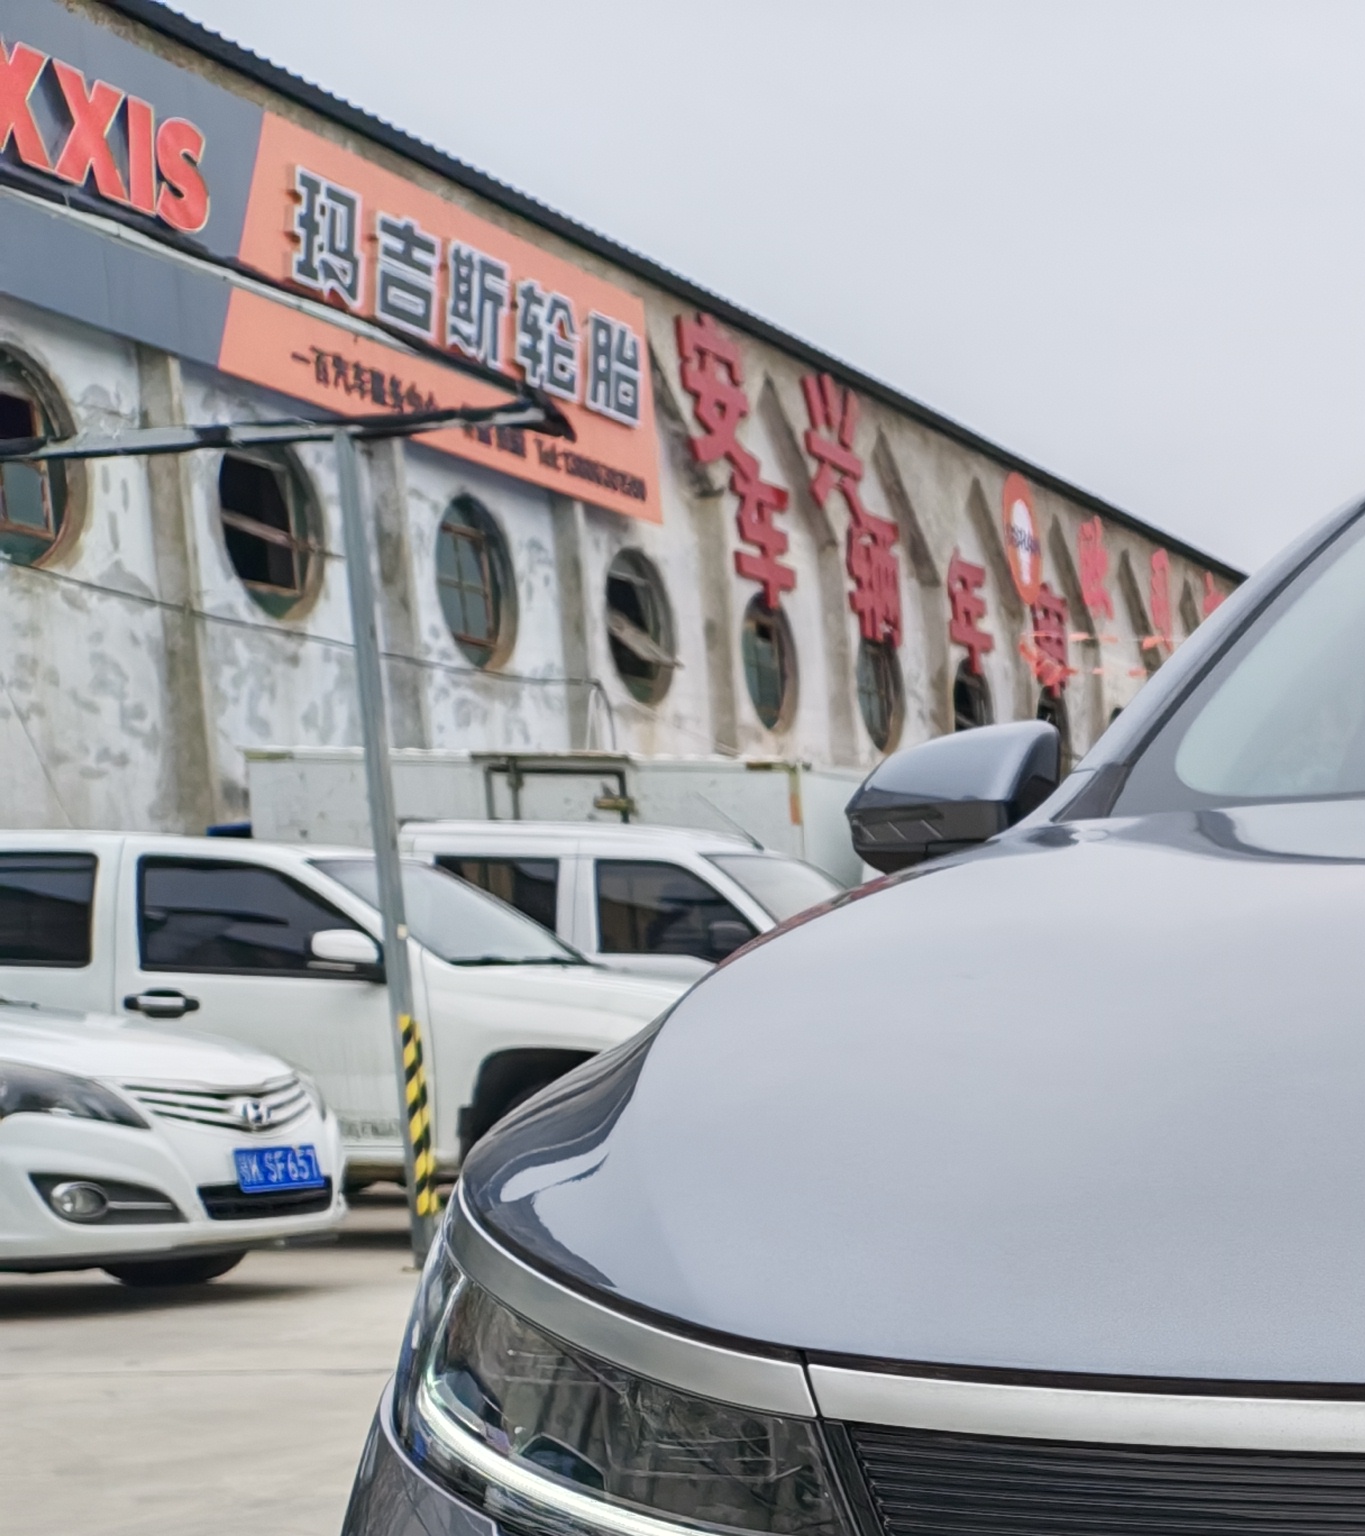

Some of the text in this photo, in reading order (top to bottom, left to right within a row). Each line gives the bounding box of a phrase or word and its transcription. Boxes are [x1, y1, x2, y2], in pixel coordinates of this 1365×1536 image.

[291, 164, 643, 429] 玛吉斯轮胎
